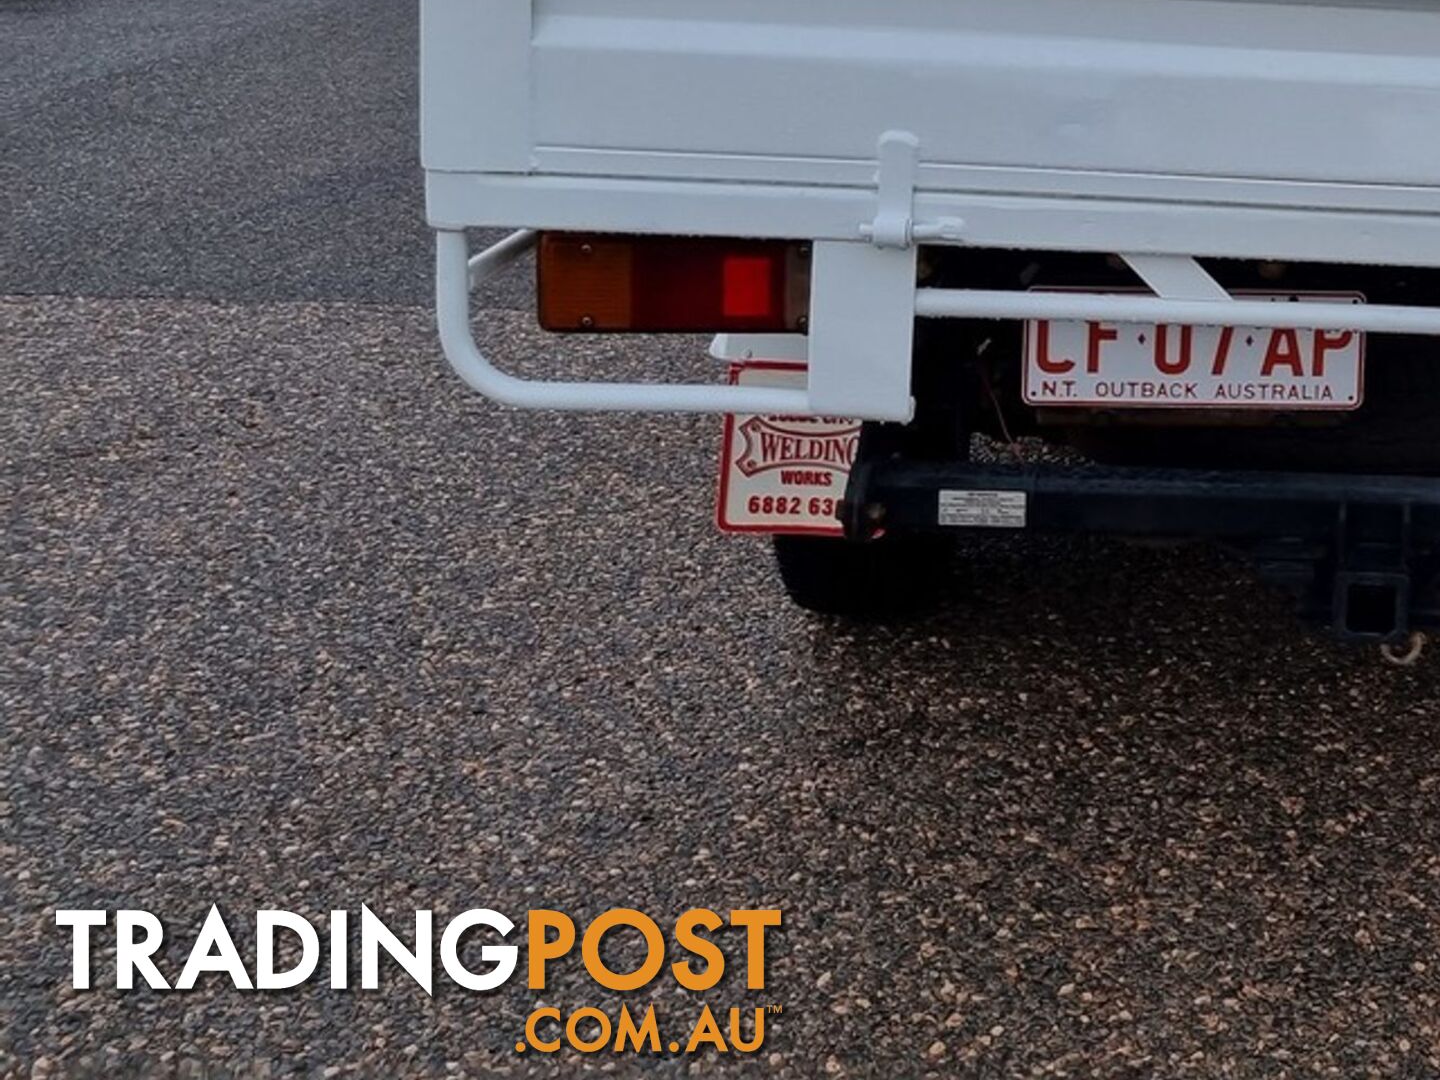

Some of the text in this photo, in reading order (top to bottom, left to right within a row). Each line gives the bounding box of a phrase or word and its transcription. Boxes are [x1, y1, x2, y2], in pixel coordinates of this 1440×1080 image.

[1041, 380, 1333, 400] N.T. OUTBACK AUSTRALIA
[781, 470, 832, 486] WORKS
[748, 495, 836, 516] 6882 63
